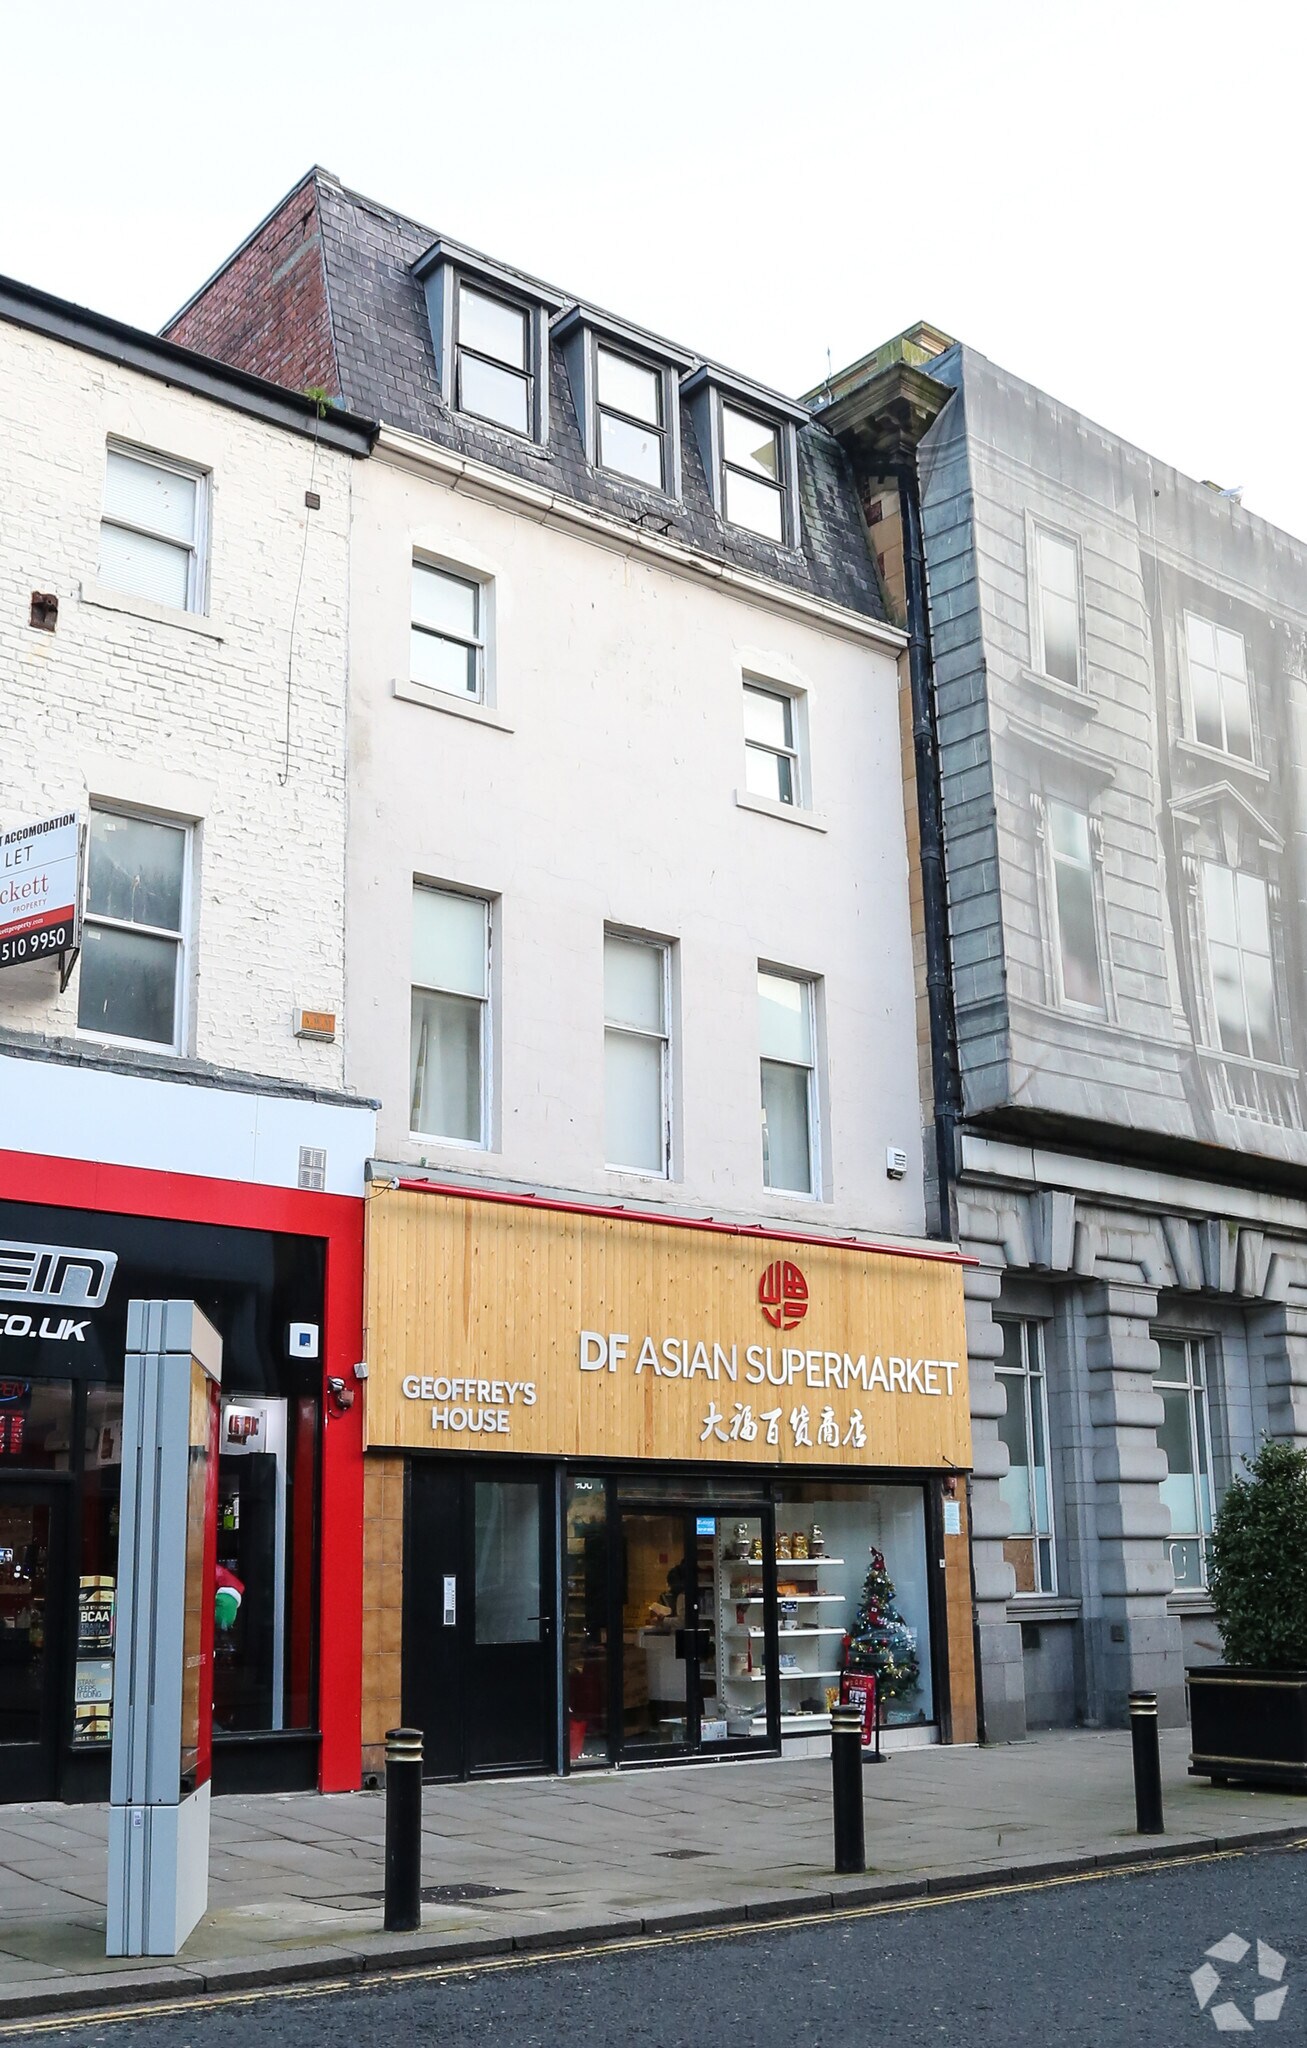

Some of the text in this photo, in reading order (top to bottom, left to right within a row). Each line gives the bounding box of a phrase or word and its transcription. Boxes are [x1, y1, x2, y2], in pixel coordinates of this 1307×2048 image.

[4, 813, 76, 846] ACCOMODATION
[5, 844, 34, 868] LET
[12, 898, 47, 914] PROPERTY
[1, 927, 66, 961] 510 9950
[580, 1331, 960, 1397] DF ASIAN SUPERMARKET
[402, 1375, 537, 1406] GEOFFREY'S
[432, 1406, 510, 1433] HOUSE
[80, 1611, 110, 1623] BCAA
